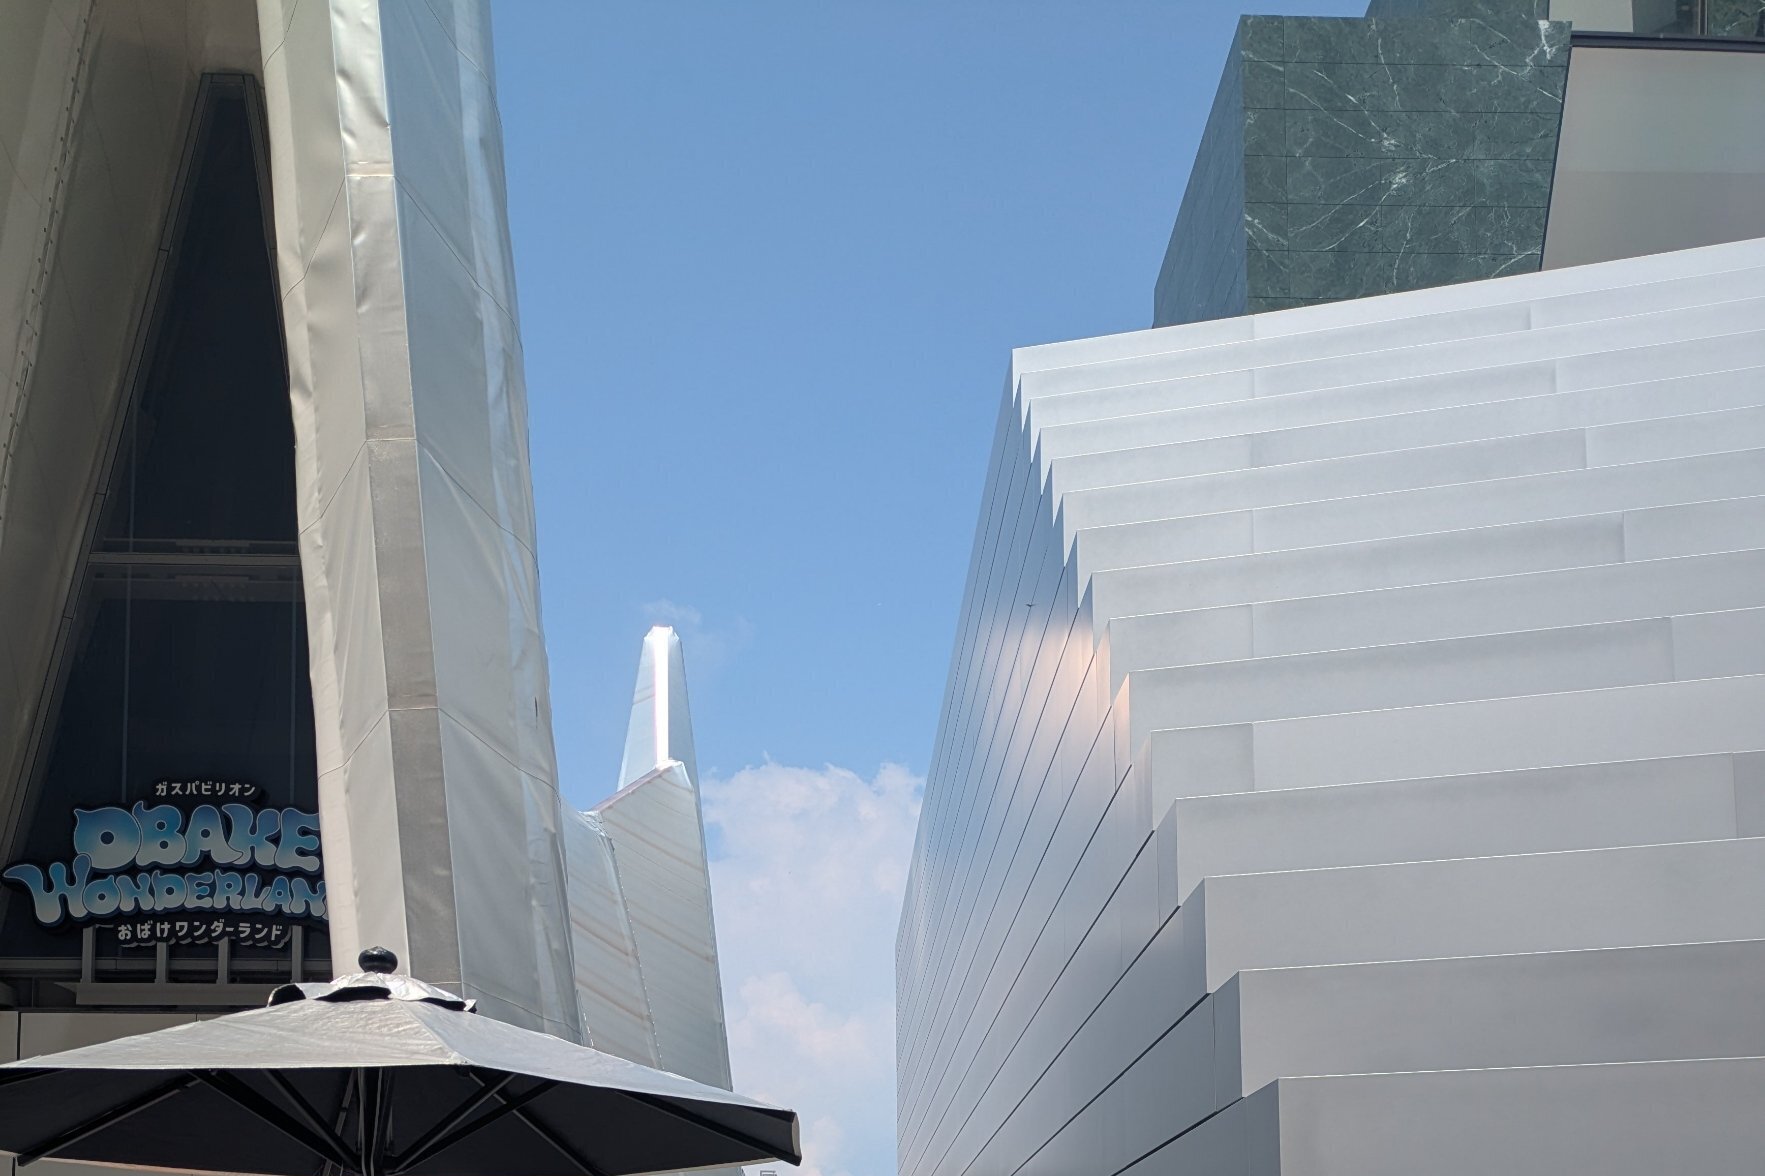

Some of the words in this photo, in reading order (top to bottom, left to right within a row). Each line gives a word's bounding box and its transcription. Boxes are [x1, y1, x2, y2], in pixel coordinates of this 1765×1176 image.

[155, 780, 256, 797] ガスパビリオン
[73, 801, 321, 871] OBAKE
[3, 852, 329, 924] WONDERLAN
[117, 918, 284, 942] おばけワンダーランド
